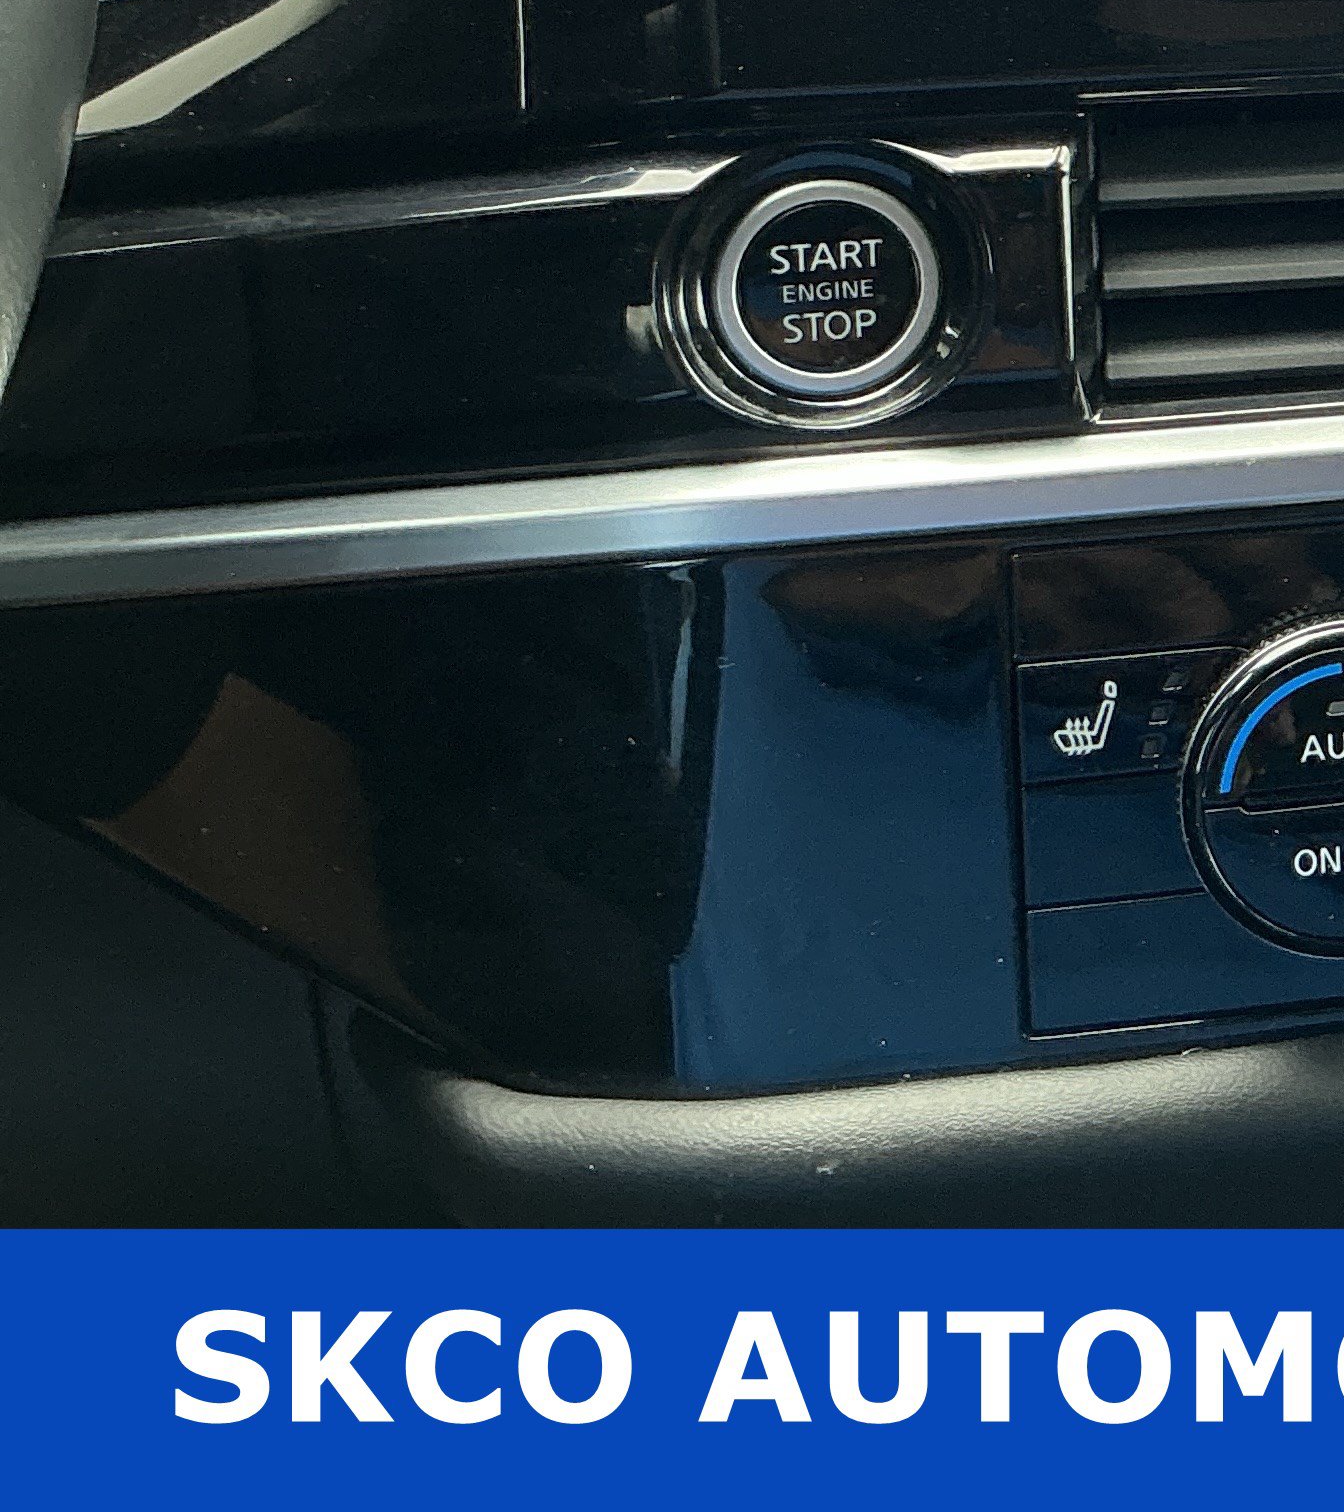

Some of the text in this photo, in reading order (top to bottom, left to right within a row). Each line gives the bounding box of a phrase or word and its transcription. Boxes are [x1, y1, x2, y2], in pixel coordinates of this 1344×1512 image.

[769, 237, 884, 276] START
[782, 278, 875, 305] ENGINE
[782, 308, 878, 345] STOP
